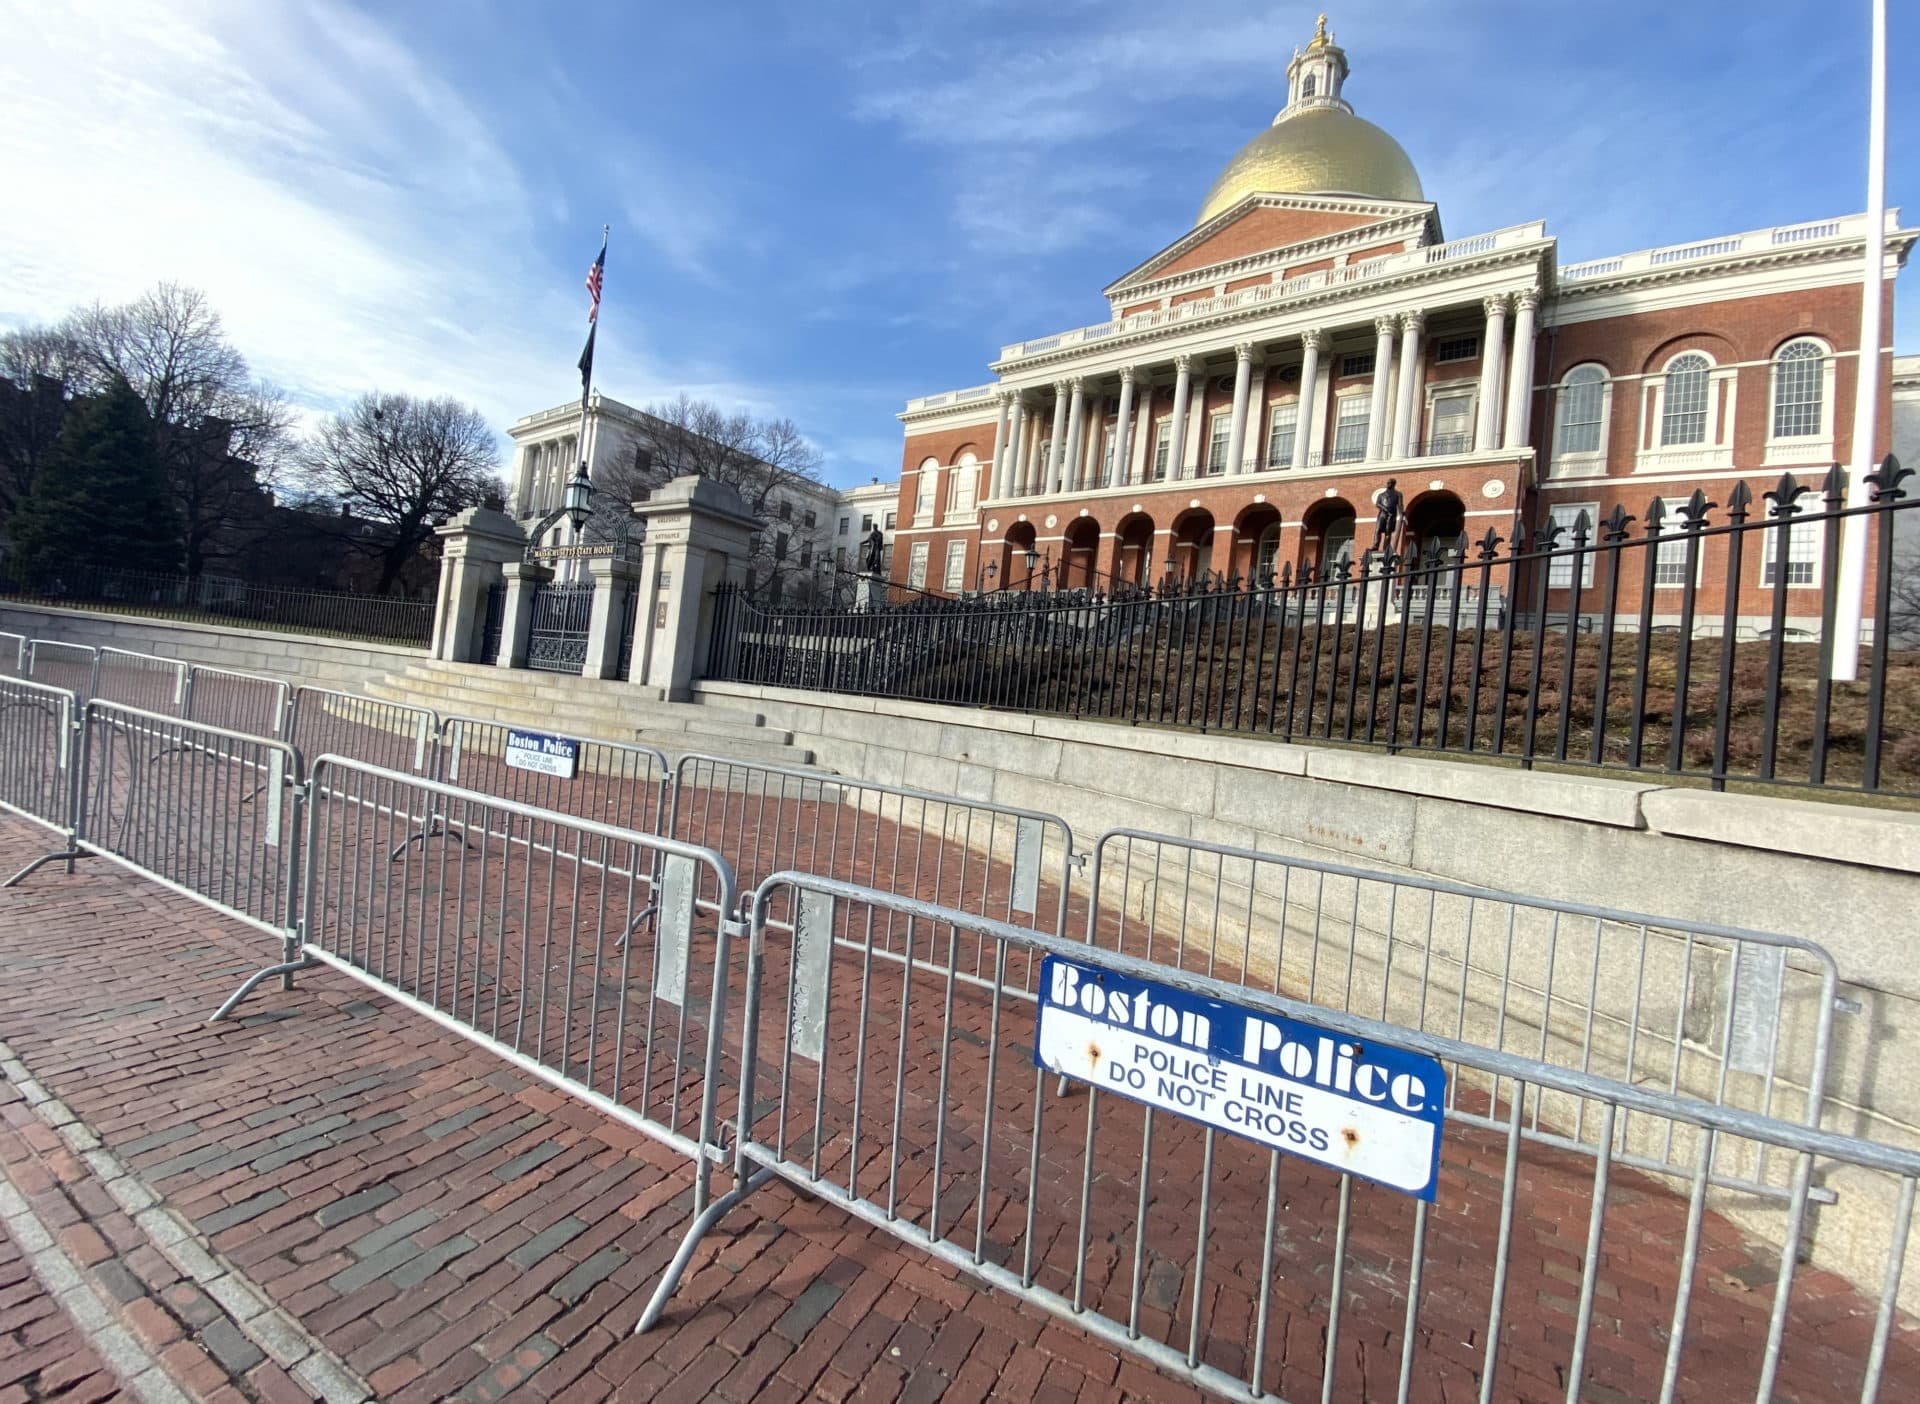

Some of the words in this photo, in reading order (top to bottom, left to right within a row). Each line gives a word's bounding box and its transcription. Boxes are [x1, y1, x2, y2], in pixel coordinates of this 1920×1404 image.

[593, 544, 614, 554] HOUSE
[509, 732, 539, 750] Boston
[543, 739, 573, 757] Police
[1051, 961, 1211, 1050] Boston
[1243, 1016, 1426, 1112] Police
[1109, 1060, 1146, 1090] DO
[1157, 1076, 1212, 1111] NOT
[1223, 1099, 1330, 1152] CROSS
[1133, 1044, 1228, 1092] POLICE
[1241, 1078, 1304, 1117] LINE
